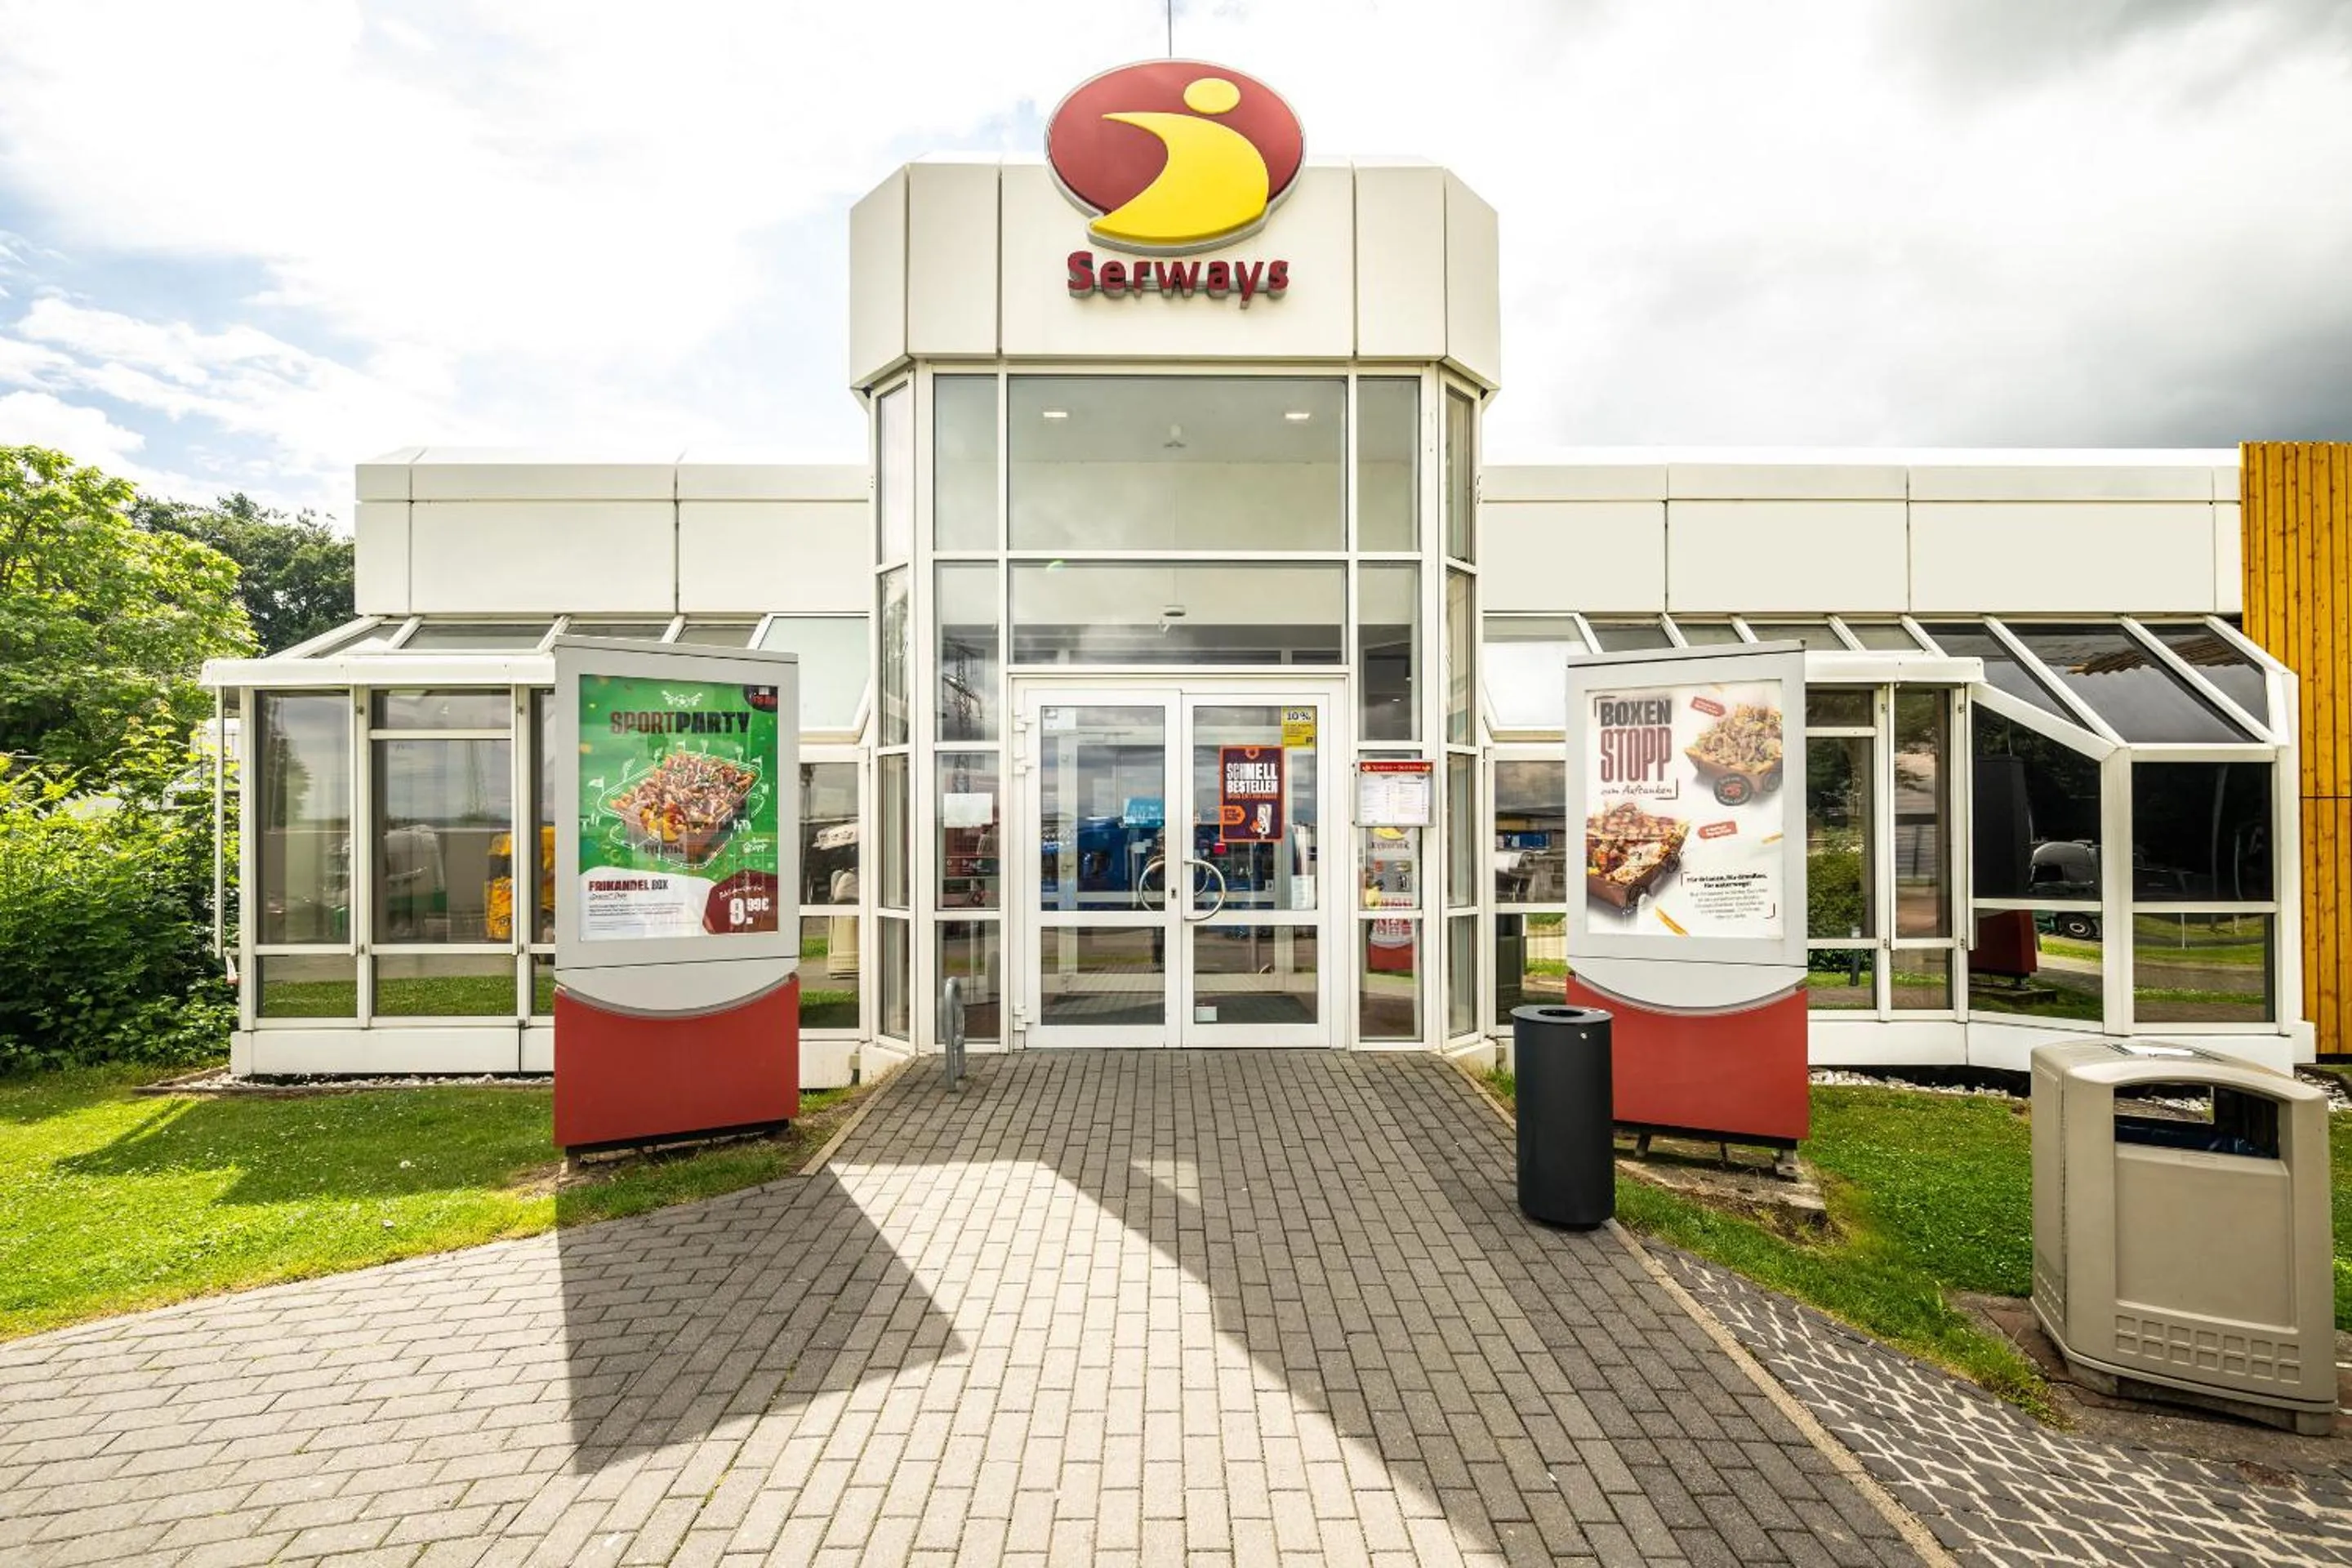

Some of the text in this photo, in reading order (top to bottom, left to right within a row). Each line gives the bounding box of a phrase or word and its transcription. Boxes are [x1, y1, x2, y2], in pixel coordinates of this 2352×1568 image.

[1067, 250, 1289, 309] Serways
[1287, 711, 1298, 720] 10
[1600, 699, 1672, 727] BOXEN
[1600, 726, 1672, 783] STOPP
[1227, 763, 1278, 780] SCHNELL
[1227, 780, 1278, 794] BESTELLEN
[589, 879, 669, 892] FRIKANDEL BOX
